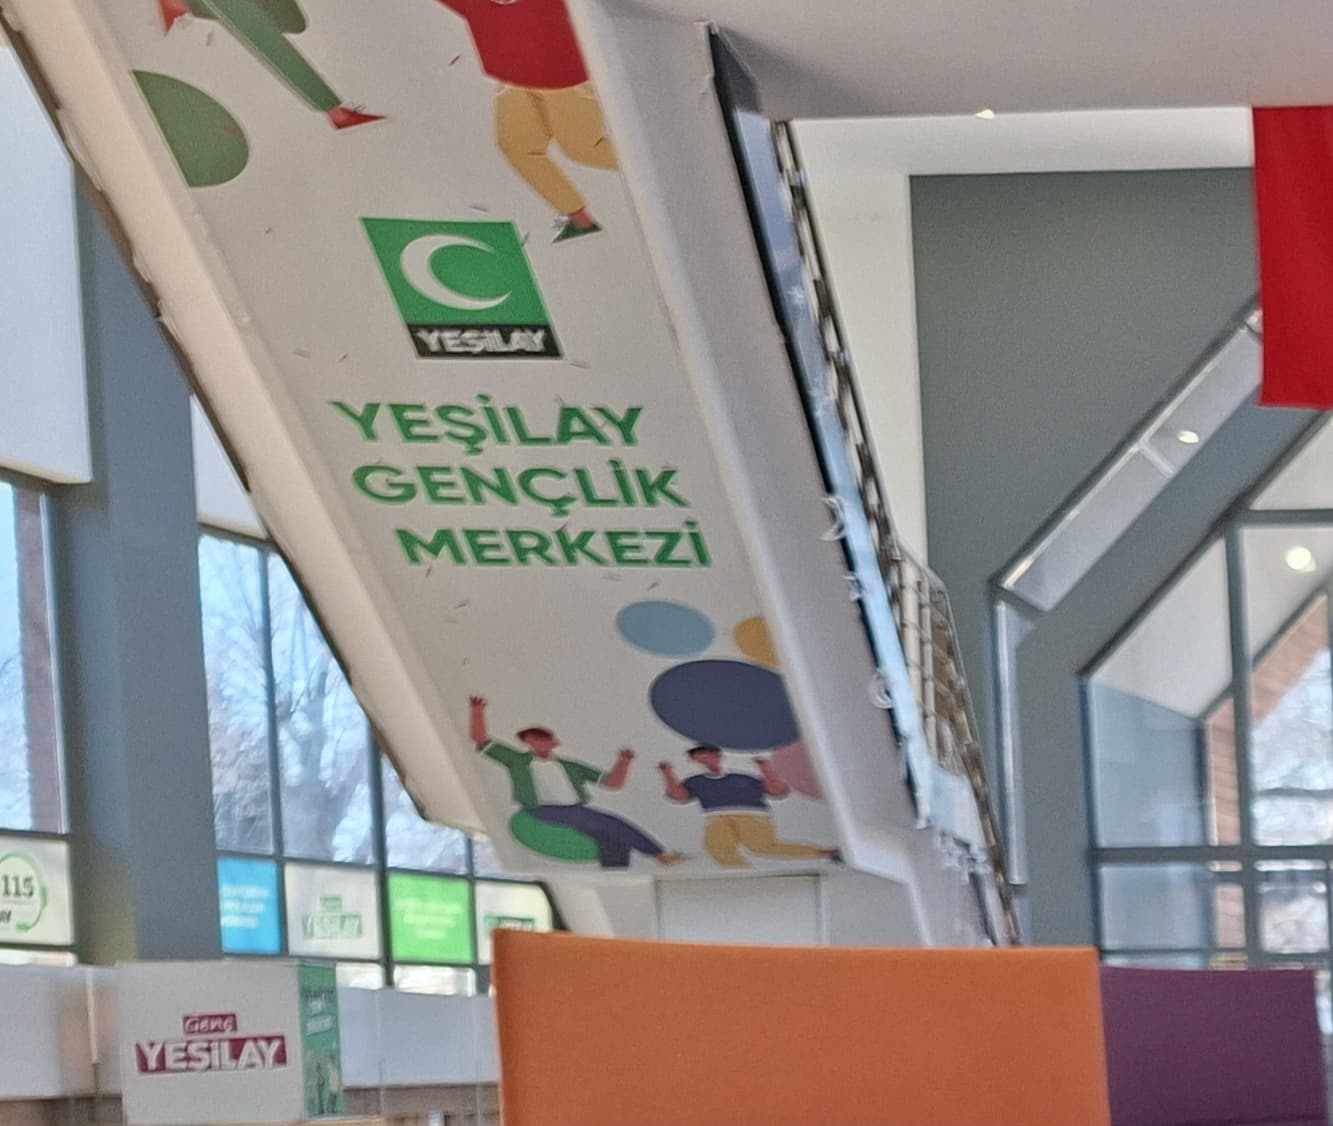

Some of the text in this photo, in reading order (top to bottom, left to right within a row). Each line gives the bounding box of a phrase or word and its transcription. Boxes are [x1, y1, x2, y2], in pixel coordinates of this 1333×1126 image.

[414, 327, 547, 354] YEŞİLAY
[331, 393, 643, 456] YEŞİLAY
[352, 459, 691, 517] GENÇLİK
[396, 520, 713, 568] MERKEZİ
[138, 1037, 282, 1073] YEŞİLAY
